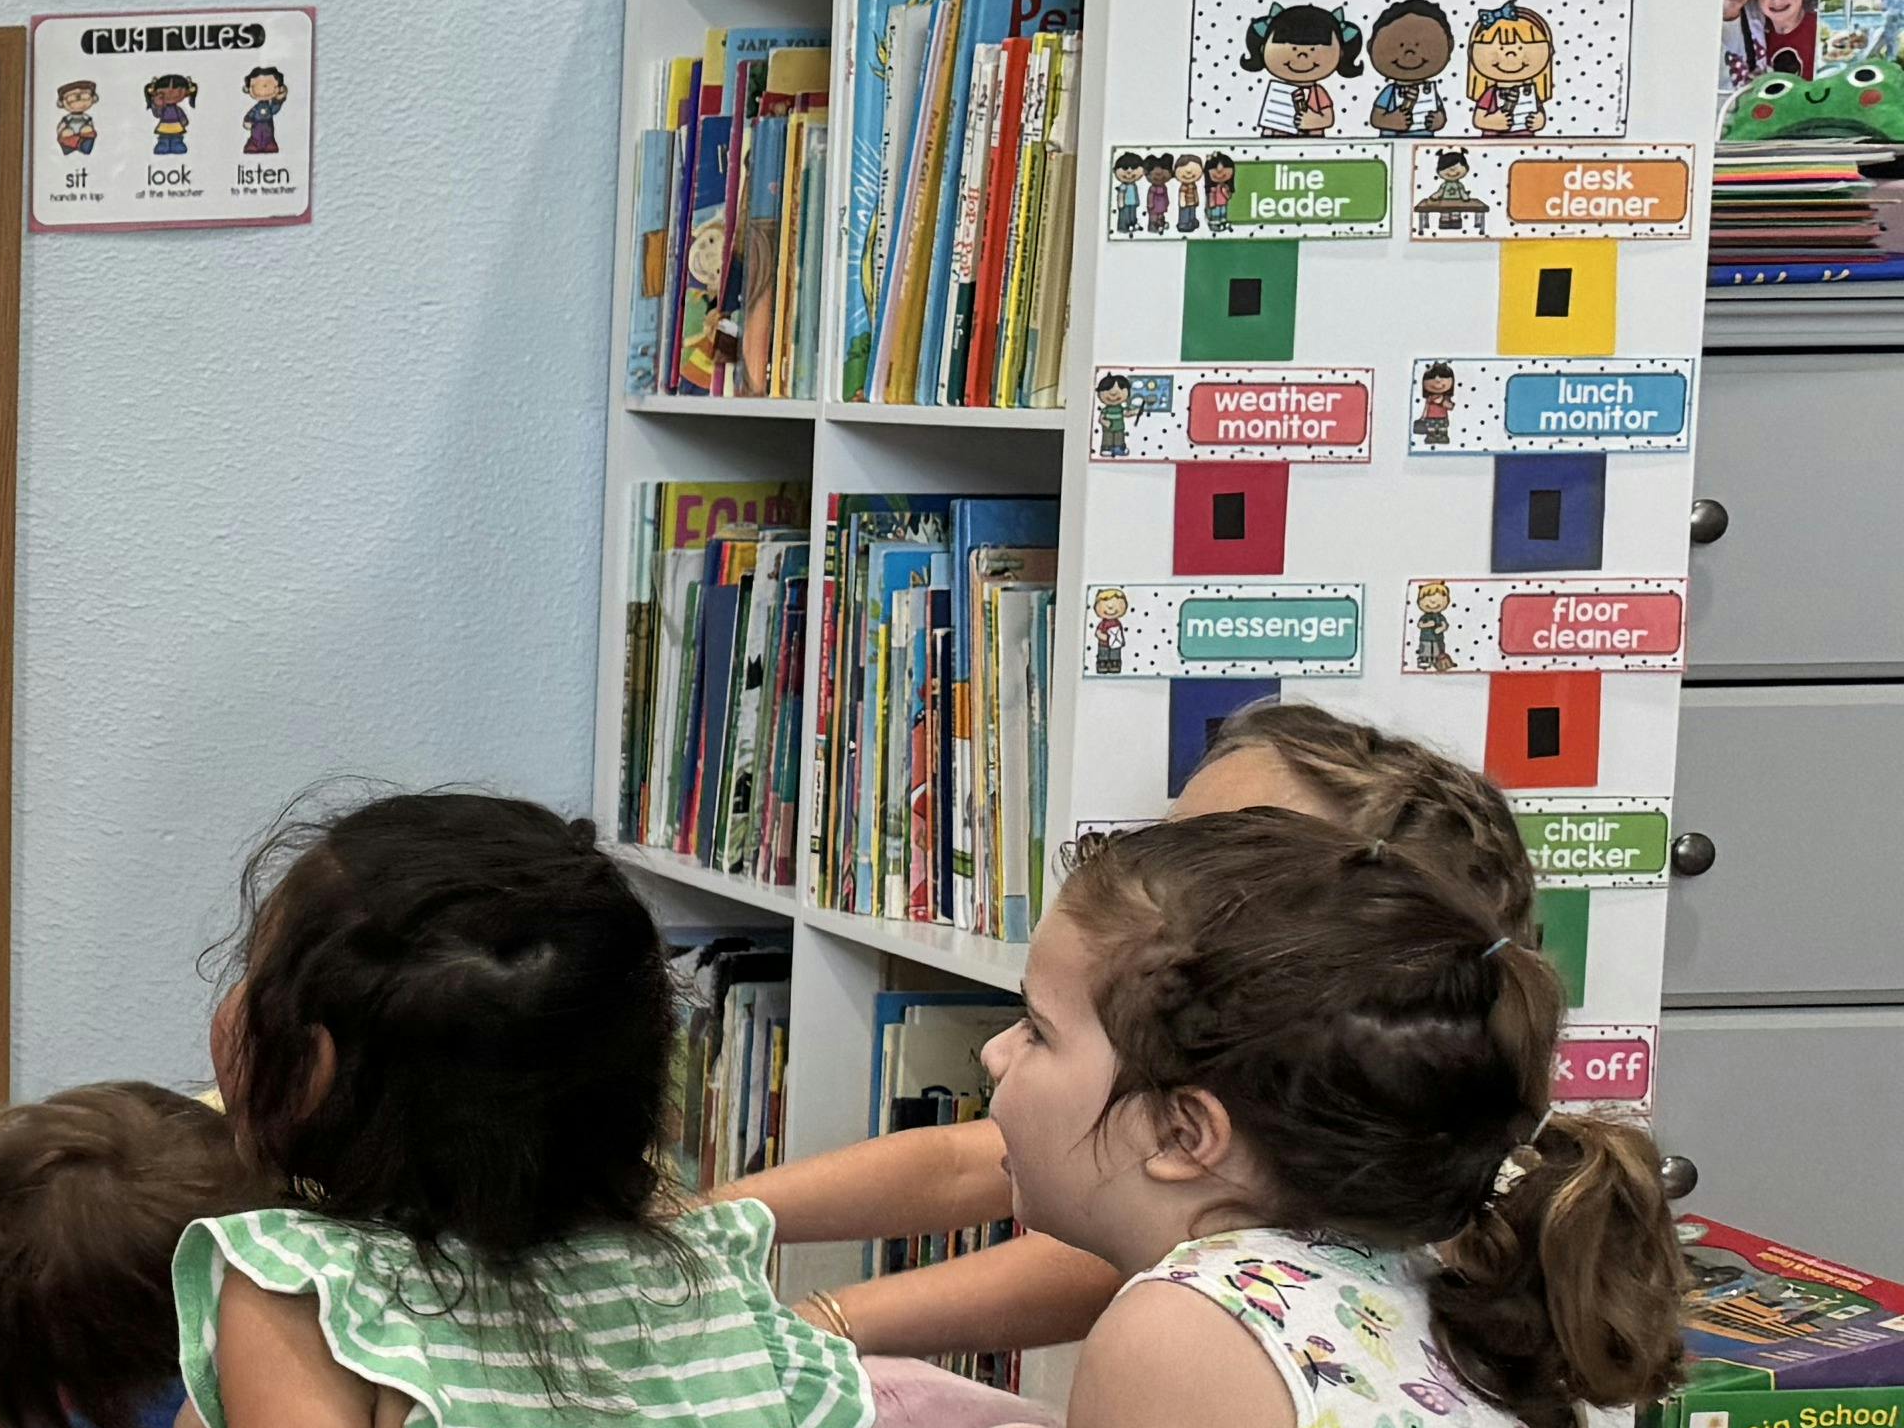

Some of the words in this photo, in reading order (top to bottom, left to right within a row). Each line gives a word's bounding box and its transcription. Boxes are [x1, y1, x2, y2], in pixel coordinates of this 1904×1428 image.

[92, 28, 149, 54] rug
[65, 168, 88, 188] sit
[148, 165, 190, 185] look
[238, 163, 289, 185] listen
[1274, 164, 1324, 190] line
[1563, 164, 1633, 191] desk
[1250, 193, 1350, 218] leader
[1545, 191, 1659, 217] cleaner
[1215, 386, 1341, 413] weather
[1557, 379, 1634, 405] lunch
[1217, 415, 1337, 440] monitor
[1539, 406, 1658, 431] monitor
[1552, 598, 1628, 625] floor
[1187, 615, 1353, 641] messenger
[1533, 625, 1647, 650] cleaner
[1544, 817, 1619, 843] chair
[1586, 1055, 1643, 1081] off
